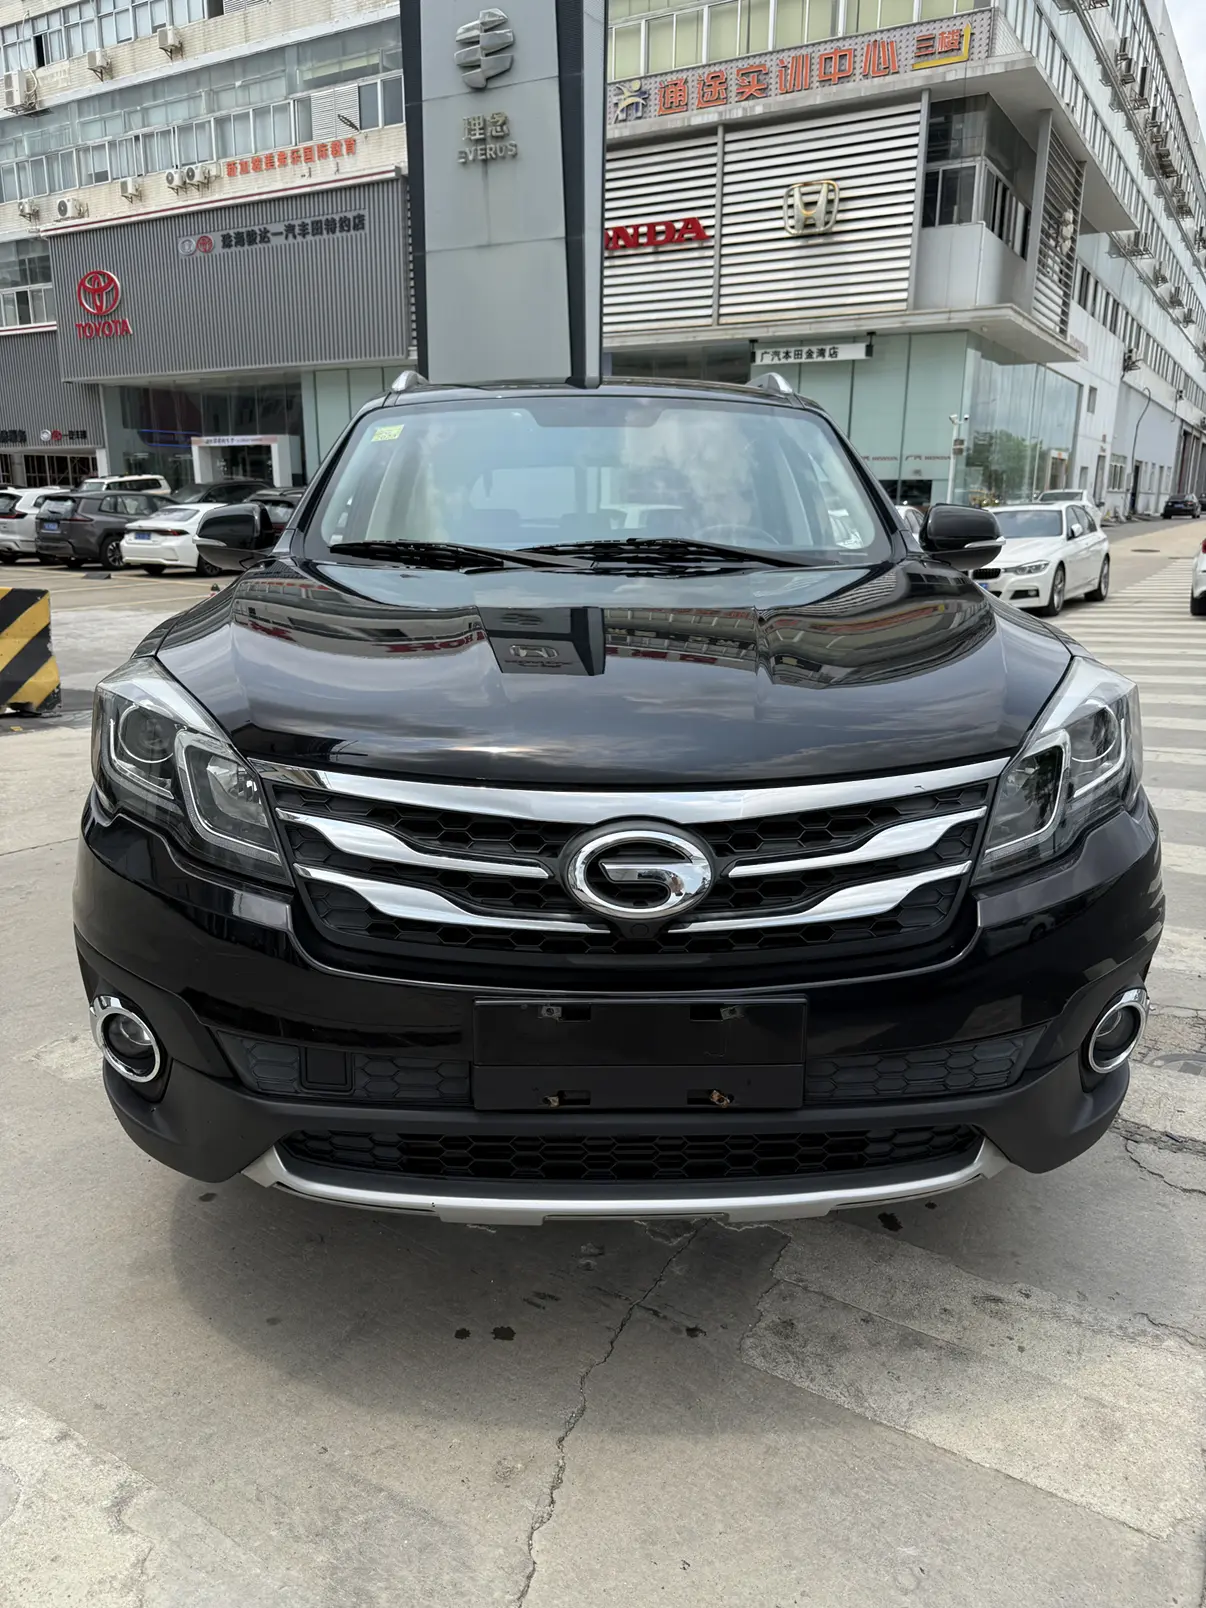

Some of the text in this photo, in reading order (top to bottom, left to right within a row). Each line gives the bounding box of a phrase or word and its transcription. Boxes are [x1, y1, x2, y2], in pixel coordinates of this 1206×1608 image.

[657, 28, 962, 115] 通途实训中心 三楼
[461, 112, 510, 141] 理念
[456, 140, 518, 164] EVERUS
[220, 213, 366, 249] 珠海骏达一汽丰田特约店
[74, 318, 133, 339] TOYOTA
[760, 347, 840, 362] 广汽本田金湾店
